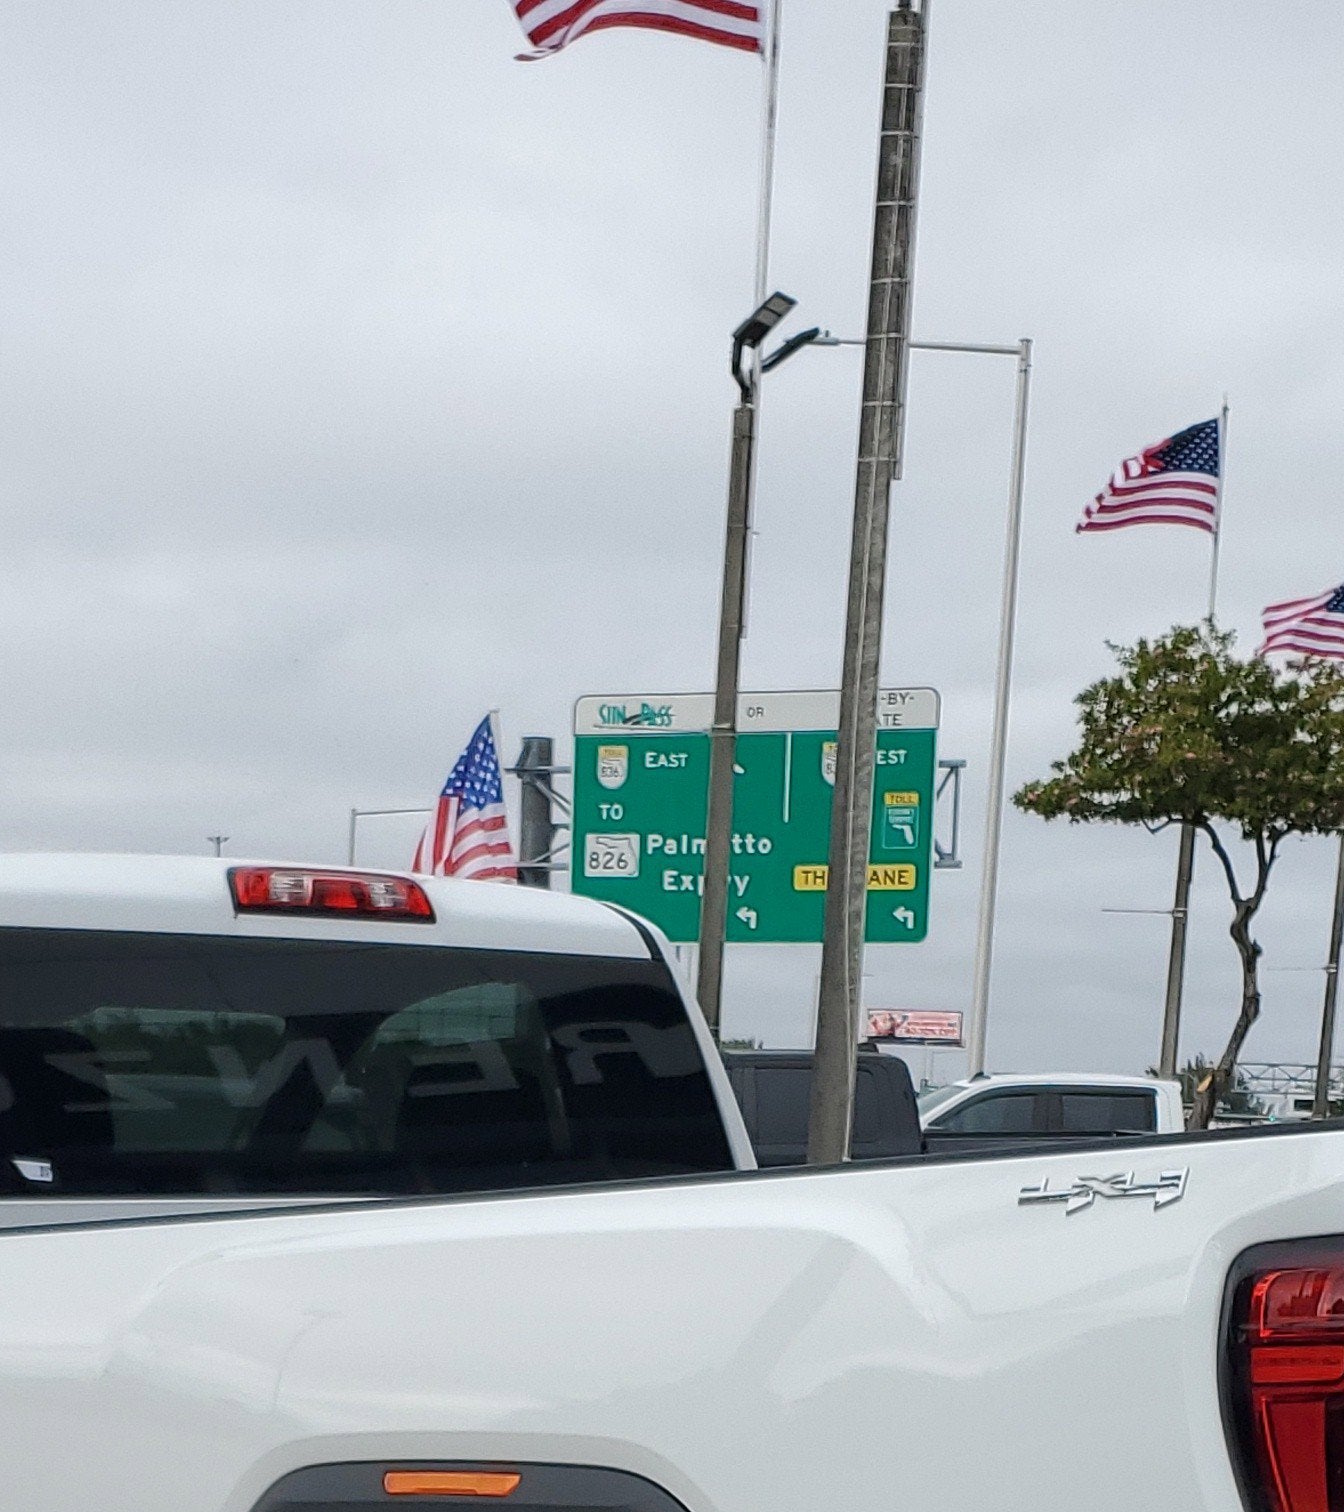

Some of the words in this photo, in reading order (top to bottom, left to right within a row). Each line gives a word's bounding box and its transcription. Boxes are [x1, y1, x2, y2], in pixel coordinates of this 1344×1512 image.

[746, 706, 765, 718] OR
[644, 751, 689, 768] EAST
[876, 750, 908, 765] EST
[887, 794, 916, 805] TOLL
[598, 803, 624, 821] TO
[645, 832, 773, 856] Palmtto
[588, 852, 629, 870] 826
[868, 869, 910, 885] ANE
